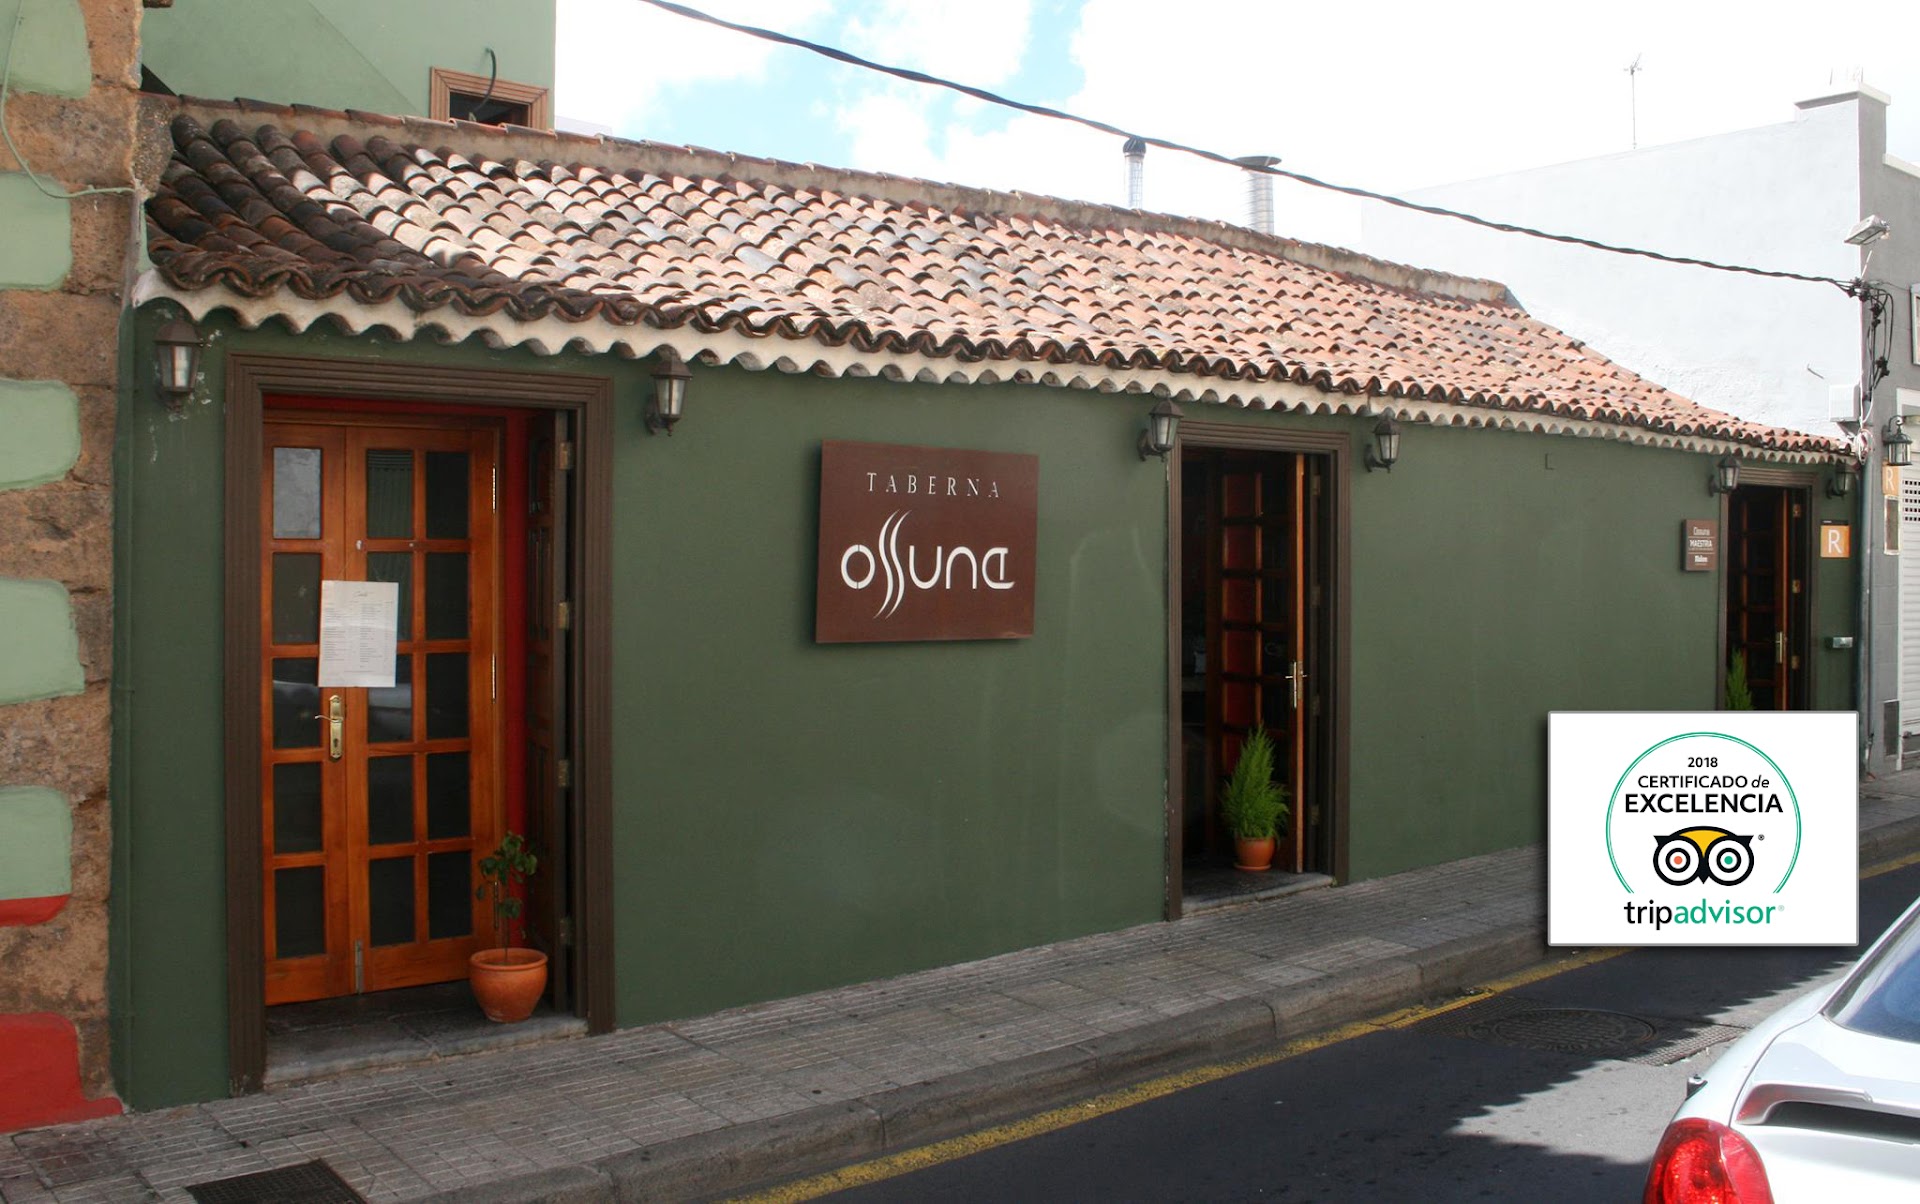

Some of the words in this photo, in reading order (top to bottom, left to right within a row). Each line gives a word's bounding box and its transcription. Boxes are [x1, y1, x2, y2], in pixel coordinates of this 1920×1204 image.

[867, 472, 999, 498] TABERNA
[1885, 467, 1895, 491] R
[1828, 529, 1843, 554] R
